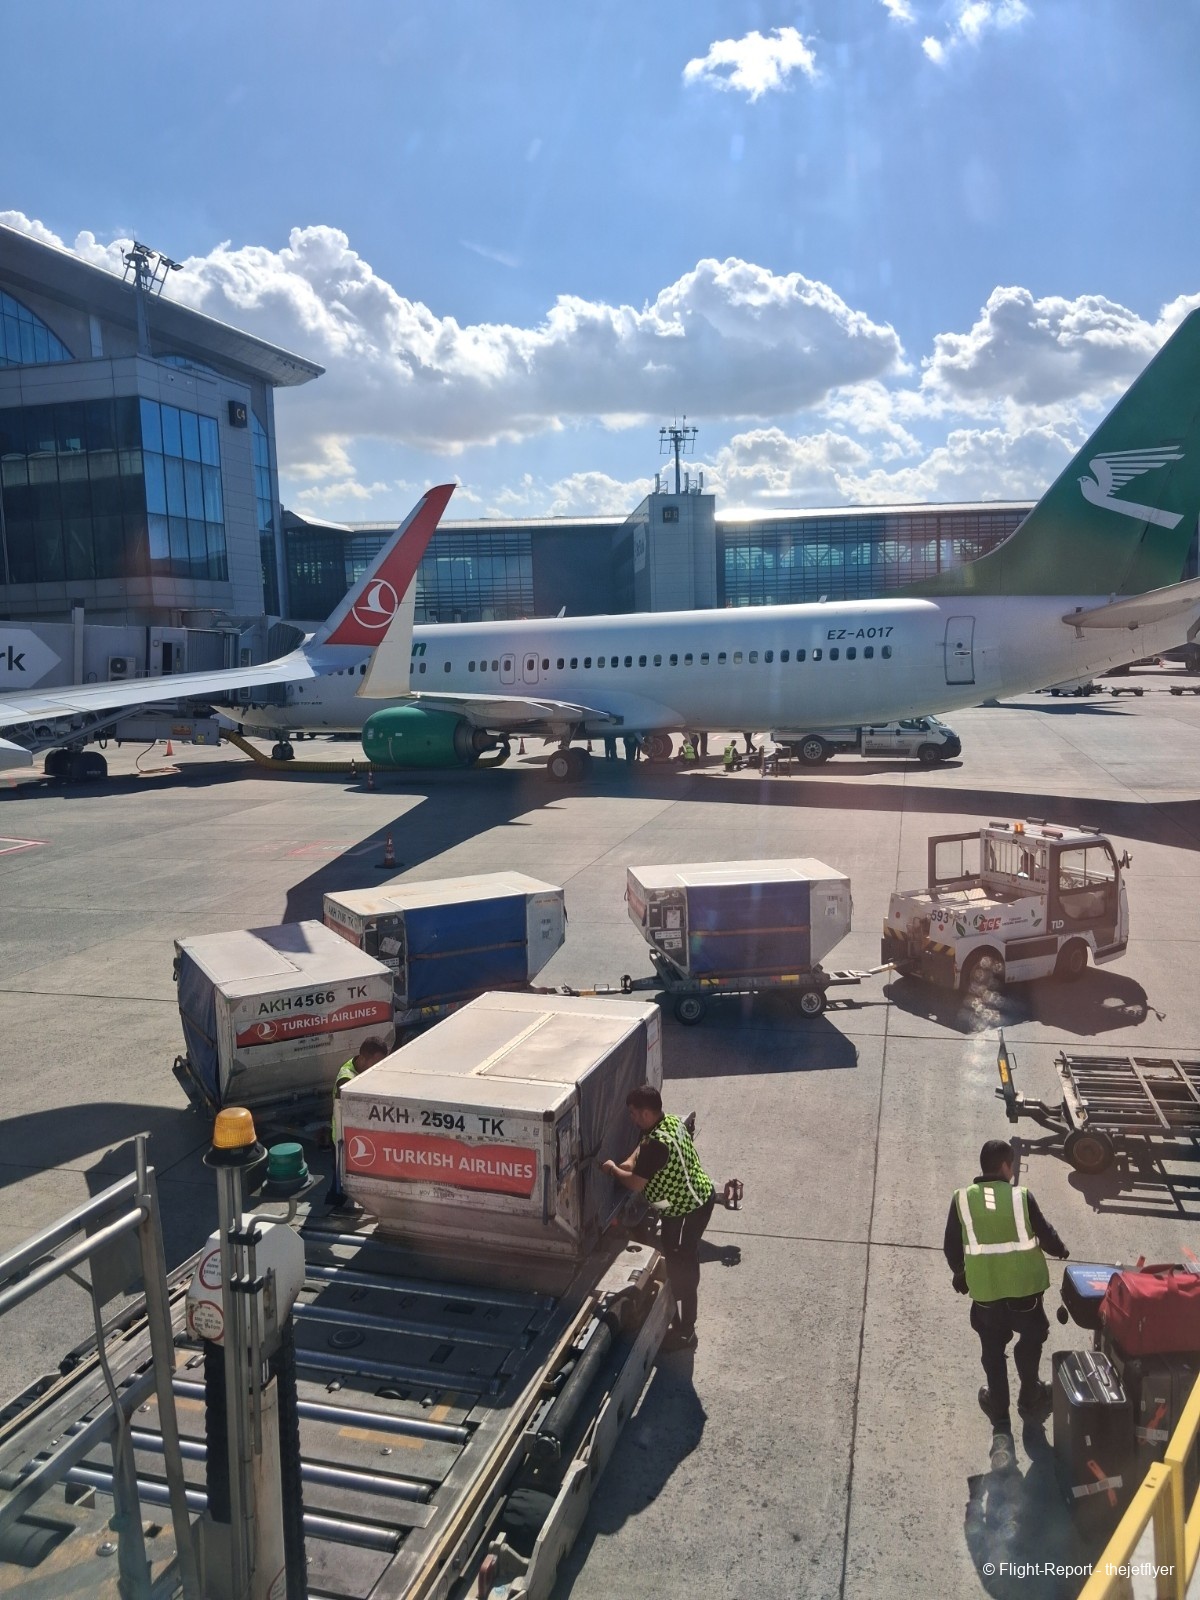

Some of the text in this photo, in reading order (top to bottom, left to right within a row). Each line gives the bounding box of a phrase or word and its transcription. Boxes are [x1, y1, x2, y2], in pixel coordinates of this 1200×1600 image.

[827, 626, 894, 640] EZ-A017
[931, 909, 949, 924] 593
[1051, 919, 1065, 930] TLD
[347, 984, 368, 999] TK
[281, 1006, 378, 1032] TURKISH AIRLINES
[420, 1110, 466, 1132] 2594
[478, 1116, 506, 1137] TK
[382, 1146, 534, 1179] TURKISH AIRLINES
